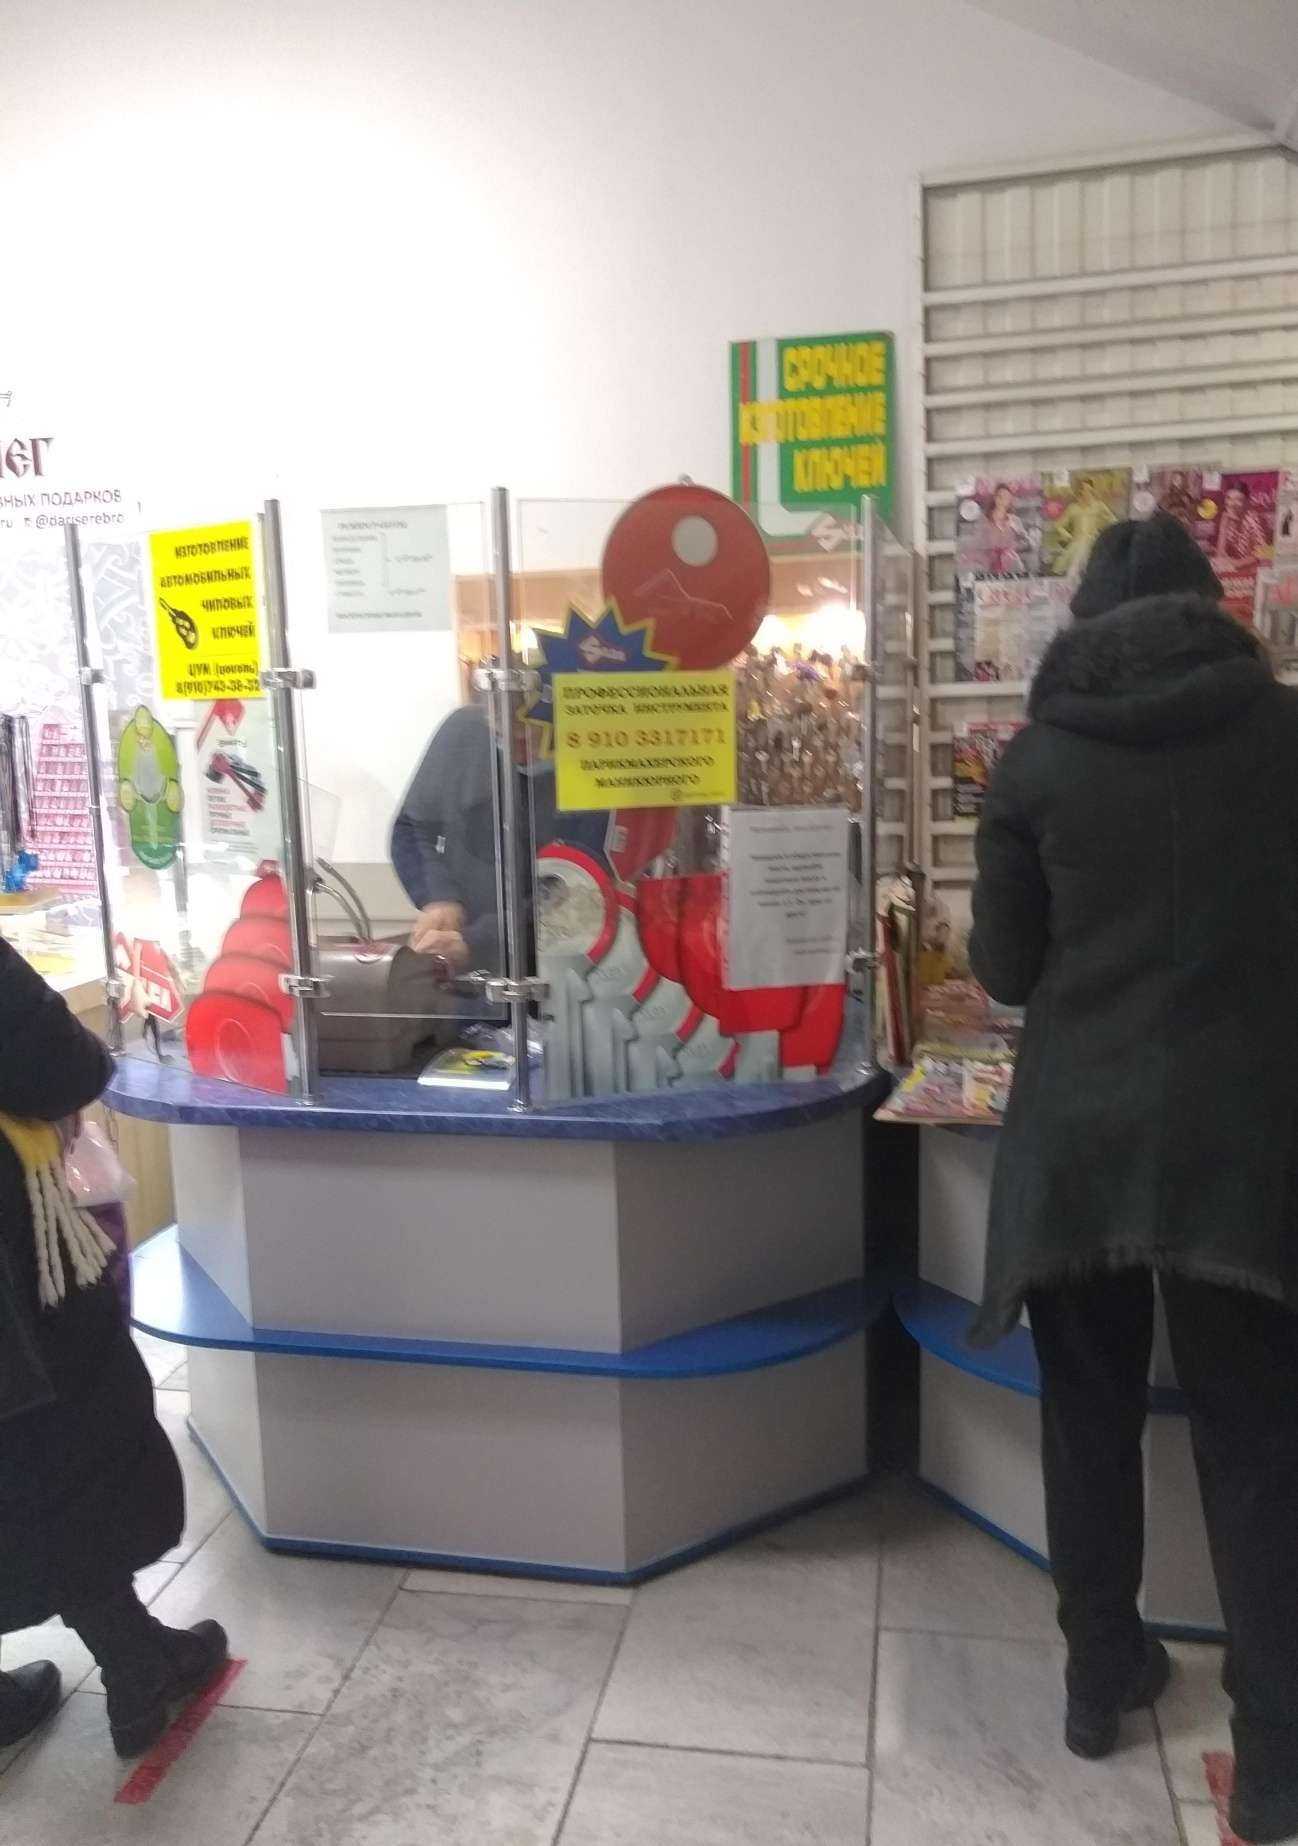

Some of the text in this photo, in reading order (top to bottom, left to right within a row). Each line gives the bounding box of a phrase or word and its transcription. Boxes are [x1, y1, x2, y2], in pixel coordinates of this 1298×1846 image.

[793, 440, 888, 493] КЛЮЧЕЙ
[40, 489, 122, 507] ПОДАРКОВ
[175, 536, 249, 559] ИЗГОТОВЛЕНИЕ
[160, 566, 252, 588] АВТОМОБИЛЬНЫХ
[202, 595, 253, 612] ЧИПОВЫХ
[212, 621, 256, 639] КЛЮЧЕЙ
[587, 729, 629, 748] 910
